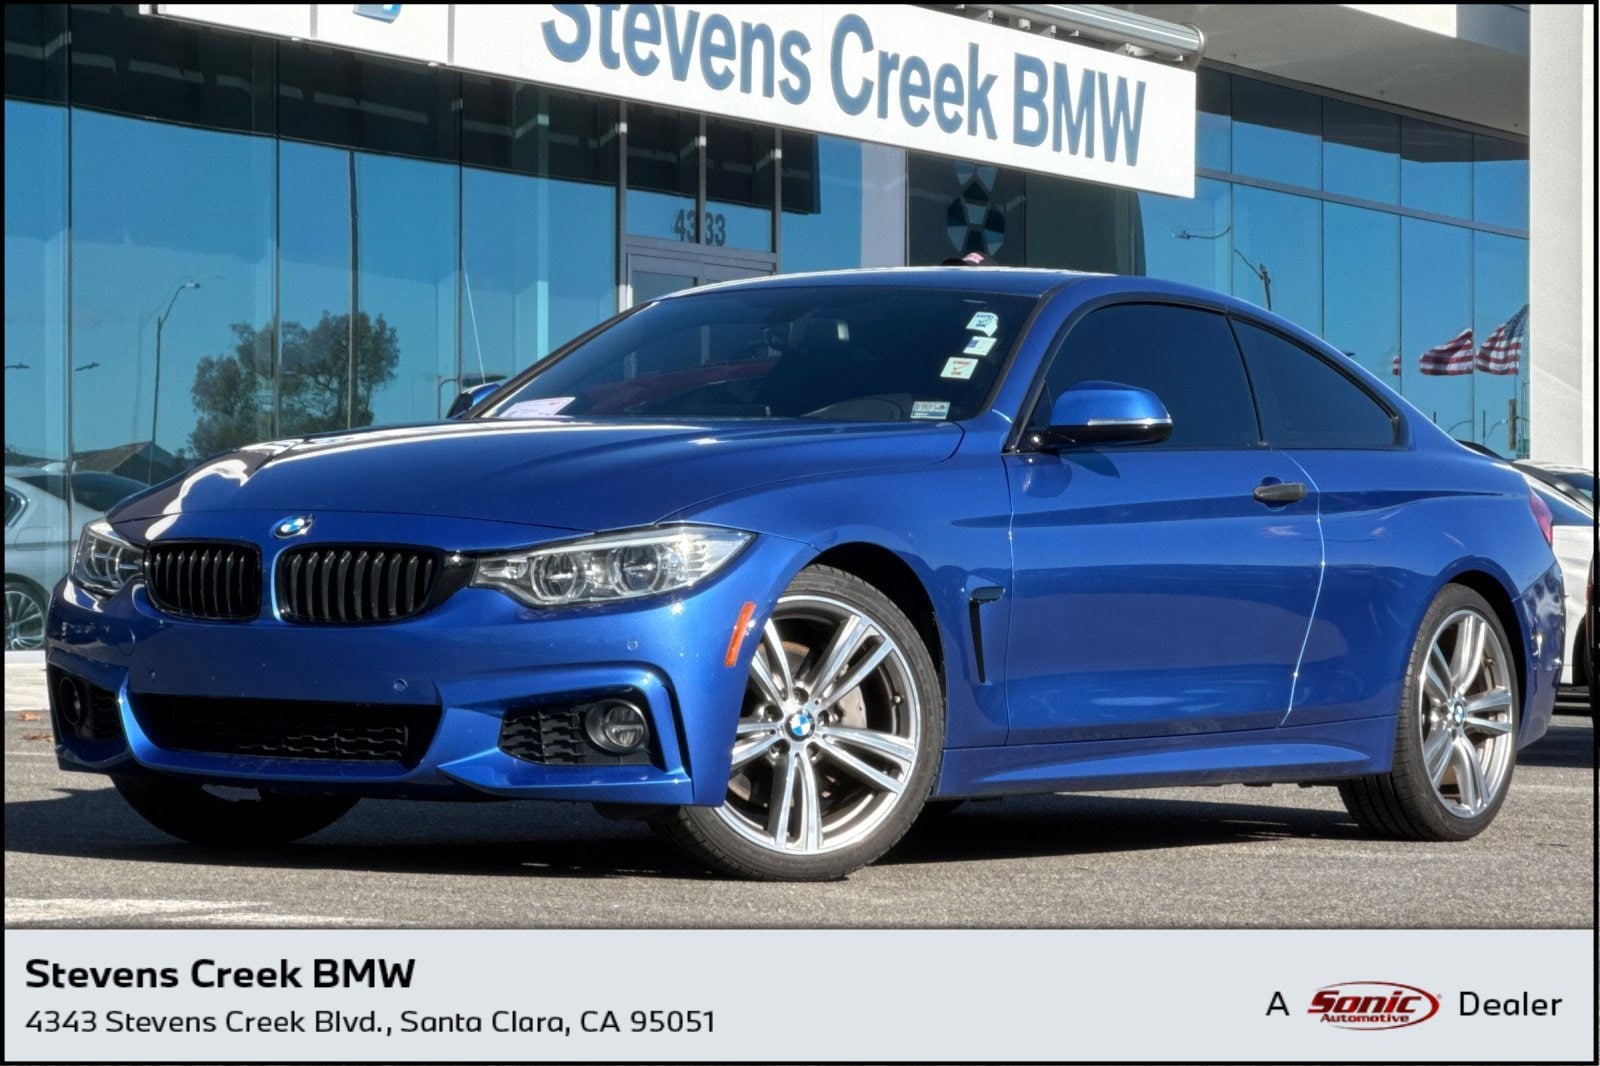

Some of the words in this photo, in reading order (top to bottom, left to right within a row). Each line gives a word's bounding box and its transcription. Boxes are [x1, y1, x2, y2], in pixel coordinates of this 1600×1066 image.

[830, 14, 998, 140] Creek
[1013, 52, 1146, 167] BMW
[674, 208, 726, 247] 4333
